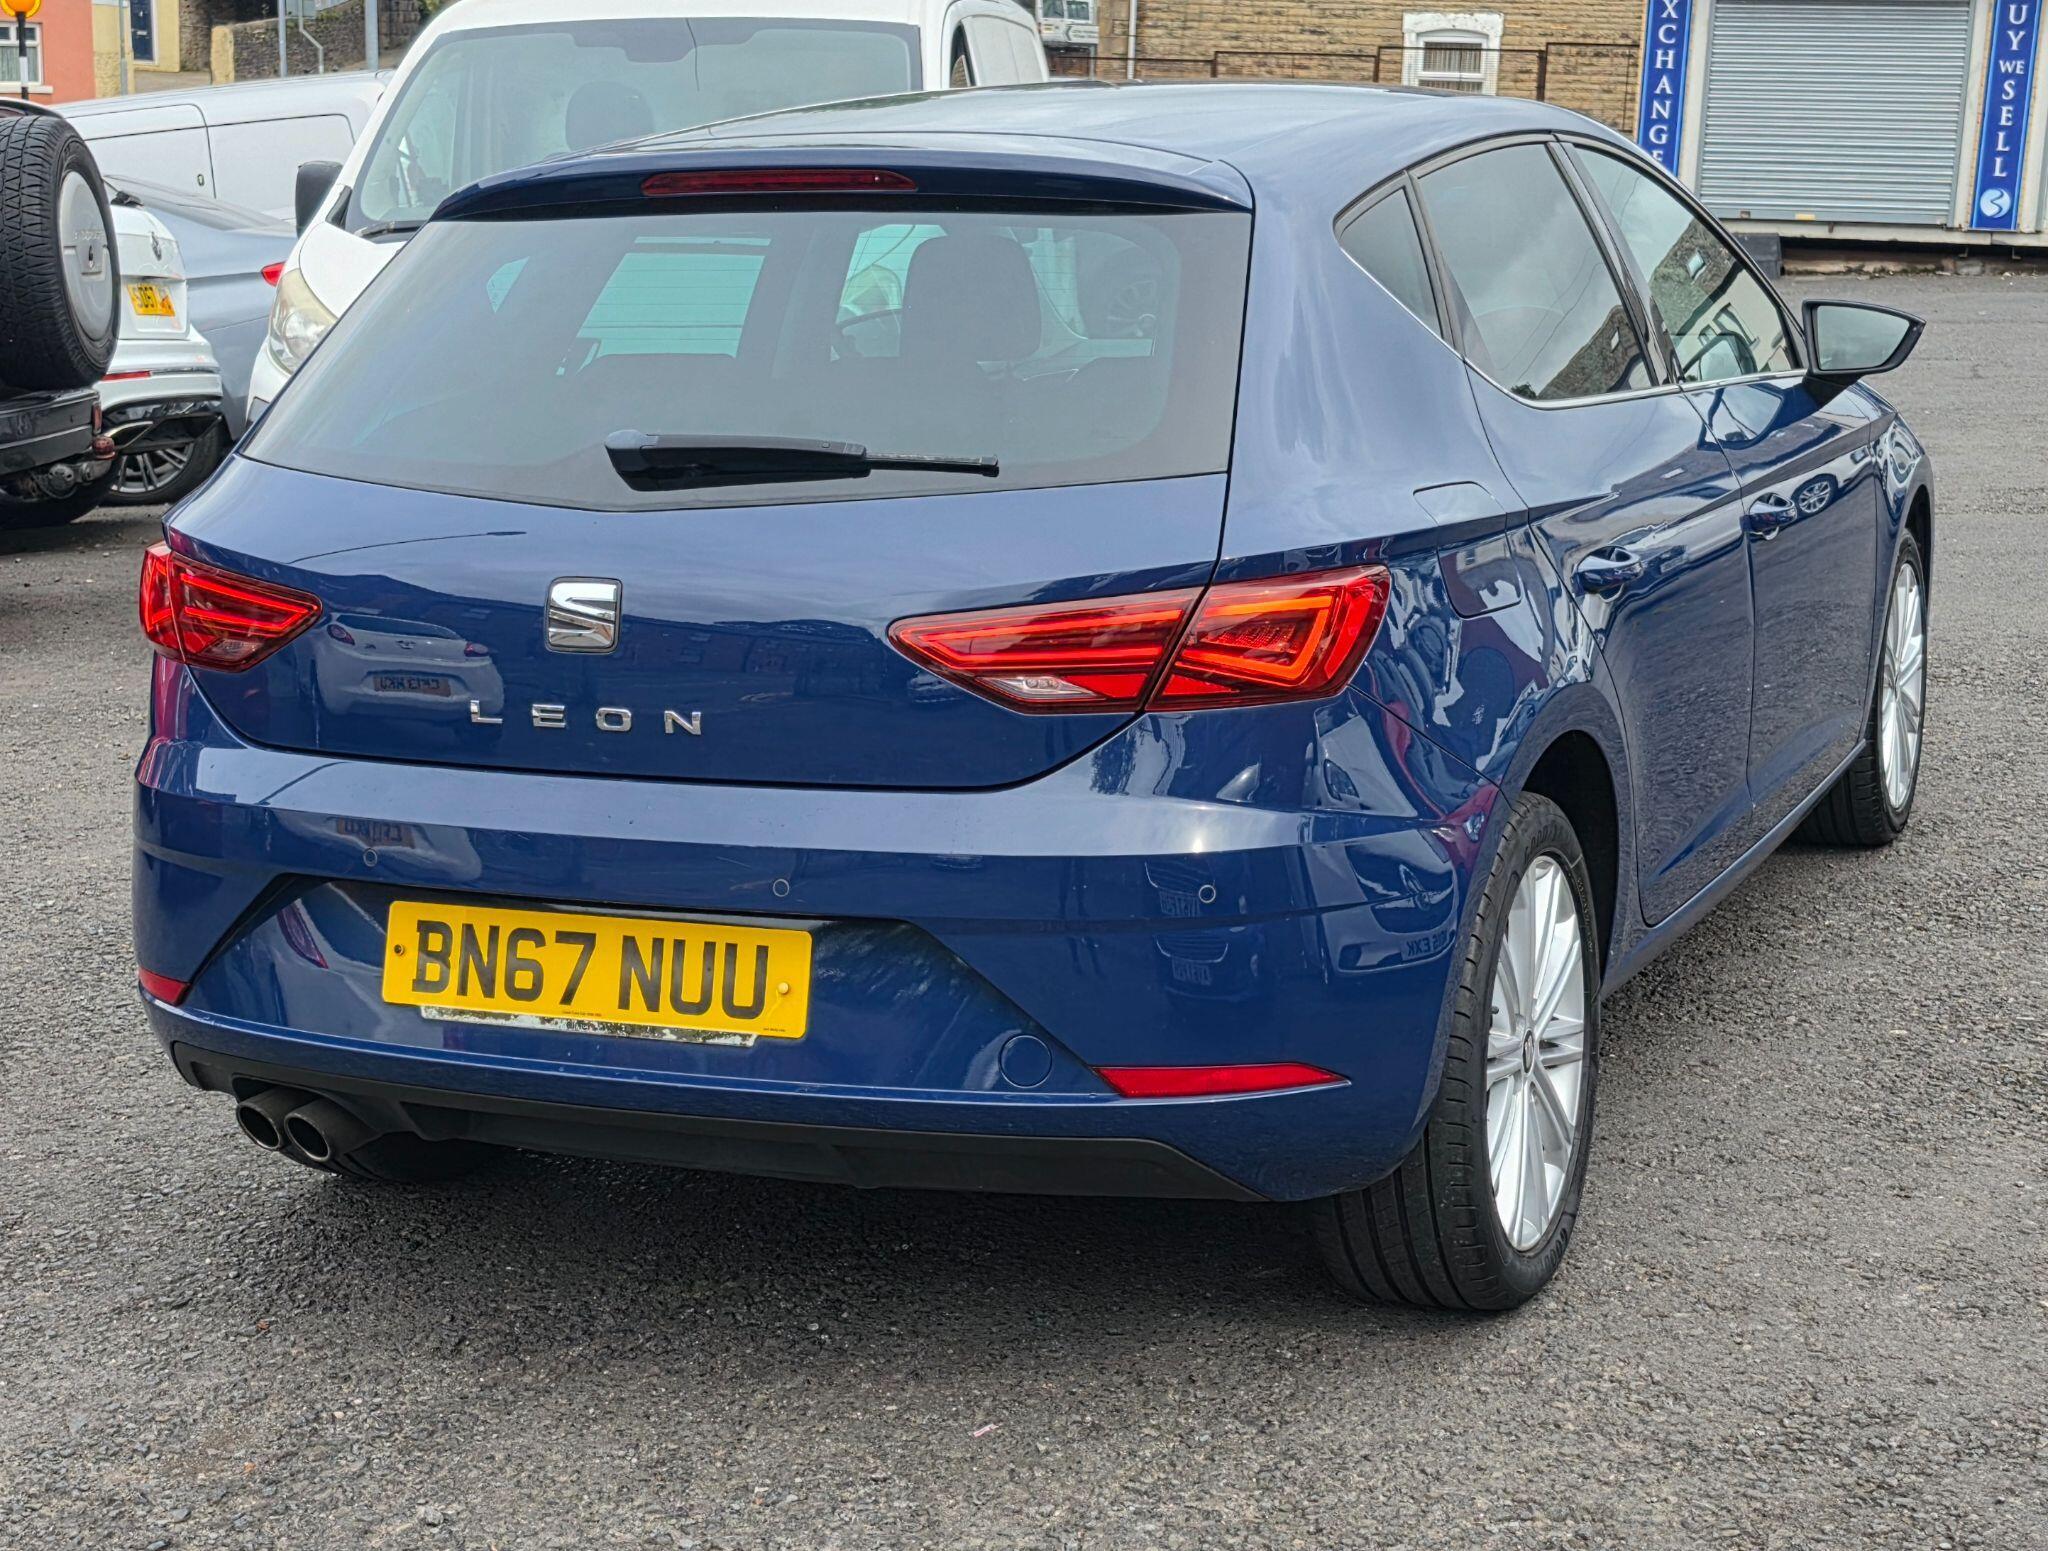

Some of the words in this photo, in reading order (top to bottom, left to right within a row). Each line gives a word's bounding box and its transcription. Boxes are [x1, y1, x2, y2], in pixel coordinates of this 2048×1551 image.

[2007, 4, 2028, 51] UY
[1999, 59, 2025, 75] WE
[1993, 80, 2016, 178] SELL
[470, 700, 702, 735] LEON
[411, 919, 597, 1006] BN67
[617, 934, 770, 1020] NUU
